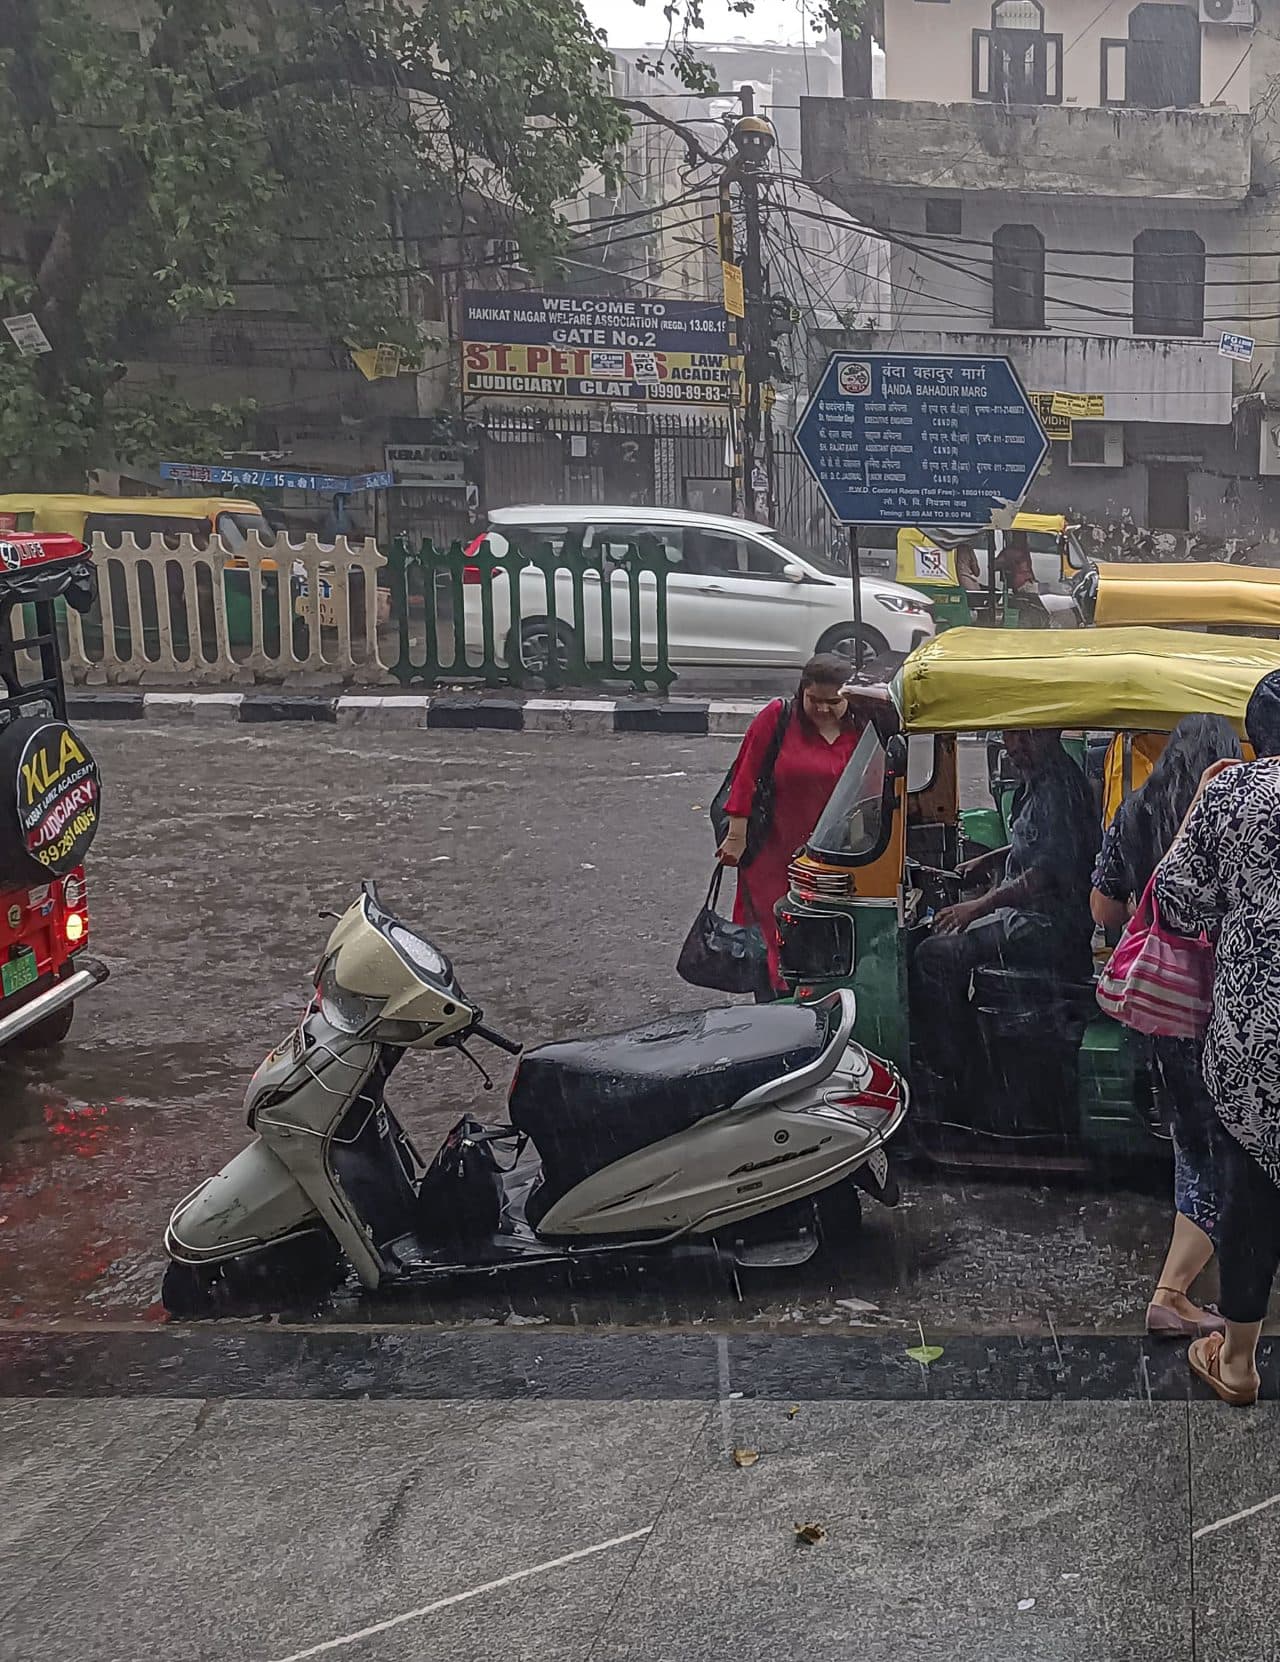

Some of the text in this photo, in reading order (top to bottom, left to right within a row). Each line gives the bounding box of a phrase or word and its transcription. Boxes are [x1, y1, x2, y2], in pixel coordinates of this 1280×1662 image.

[542, 298, 666, 316] WELCOME TO
[468, 307, 511, 321] HAKIKAT
[513, 310, 546, 323] NAGAR
[548, 312, 593, 326] WELFARE
[594, 315, 658, 329] ASSOCIATION
[552, 329, 657, 347] GATE No.2
[465, 343, 518, 372] ST.
[690, 354, 725, 368] LAW
[635, 363, 654, 372] PG
[961, 365, 985, 380] मार्ग
[470, 375, 563, 393] JUDICIARY
[579, 381, 632, 397] CLAT
[882, 383, 988, 398] BANDA BAHADUR MARG
[221, 470, 233, 482] 25
[274, 473, 285, 487] 15
[22, 730, 85, 805] KLA
[57, 762, 95, 793] ACADEMY
[34, 781, 93, 847] JUDICIARY
